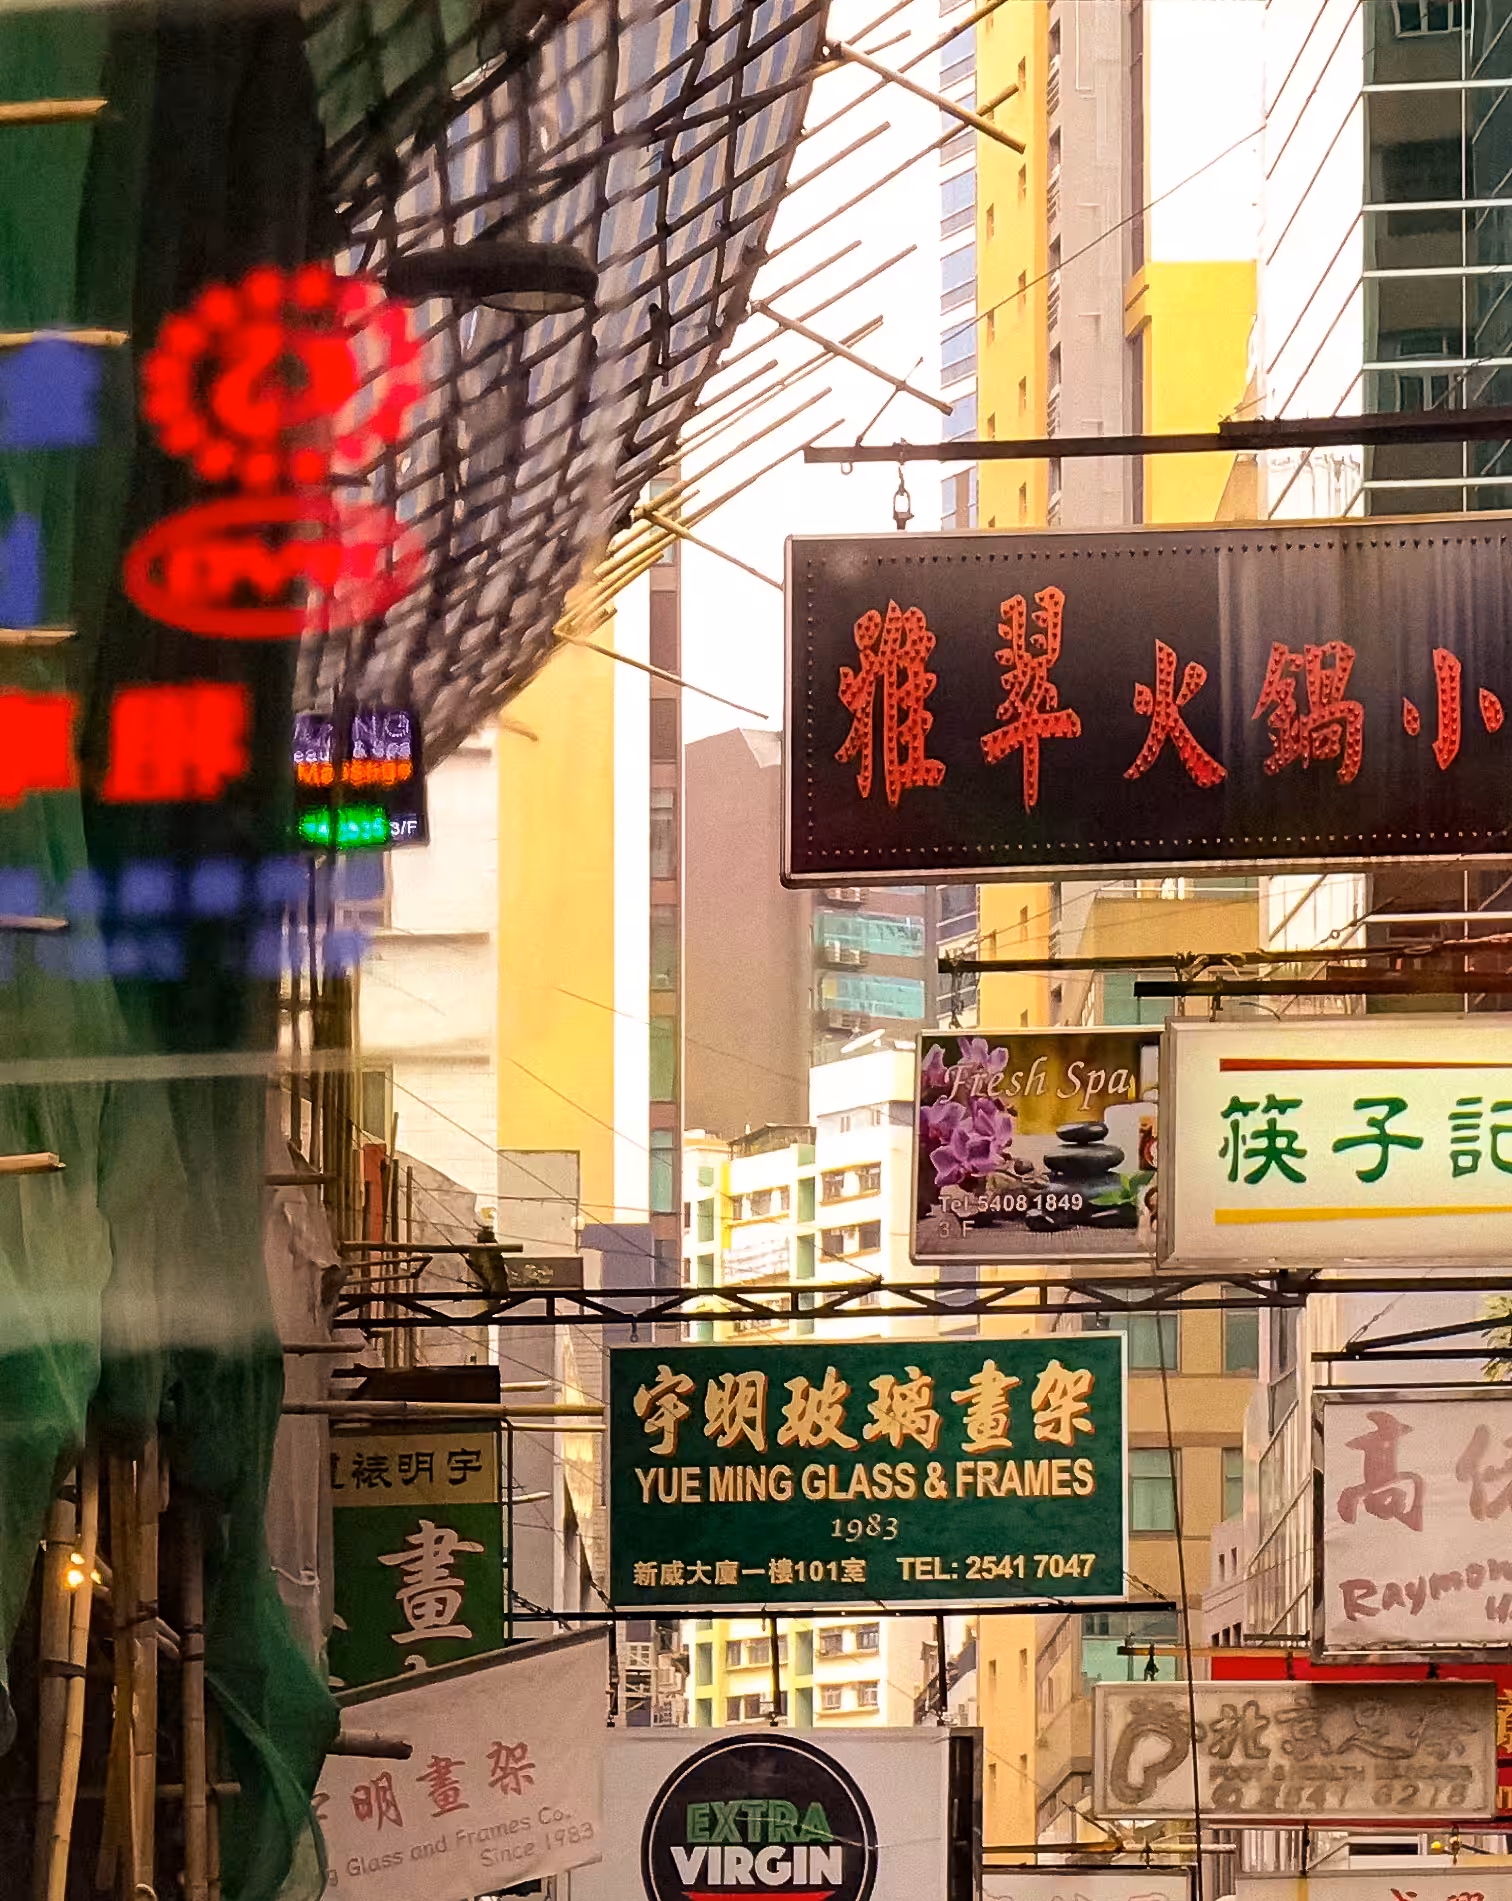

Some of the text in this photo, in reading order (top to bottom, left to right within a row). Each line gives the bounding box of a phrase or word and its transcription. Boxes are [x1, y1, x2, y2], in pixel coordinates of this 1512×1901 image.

[940, 1056, 1131, 1110] Fresh Spa
[977, 1193, 1028, 1212] 5408
[1034, 1193, 1083, 1212] 1849
[633, 1358, 1097, 1455] 宇明玻璃畫架
[634, 1456, 1096, 1503] YUE MING GLASS & FRAMES
[830, 1515, 899, 1543] 1983
[896, 1557, 958, 1582] TEL:
[964, 1555, 1026, 1581] 2541
[1036, 1552, 1097, 1578] 7047
[685, 1799, 832, 1844] EXTRA
[346, 1850, 404, 1877] Glass
[410, 1835, 448, 1861] and
[456, 1817, 532, 1849] Frames
[480, 1822, 595, 1868] Since 1983
[671, 1845, 843, 1886] VIRGIN
